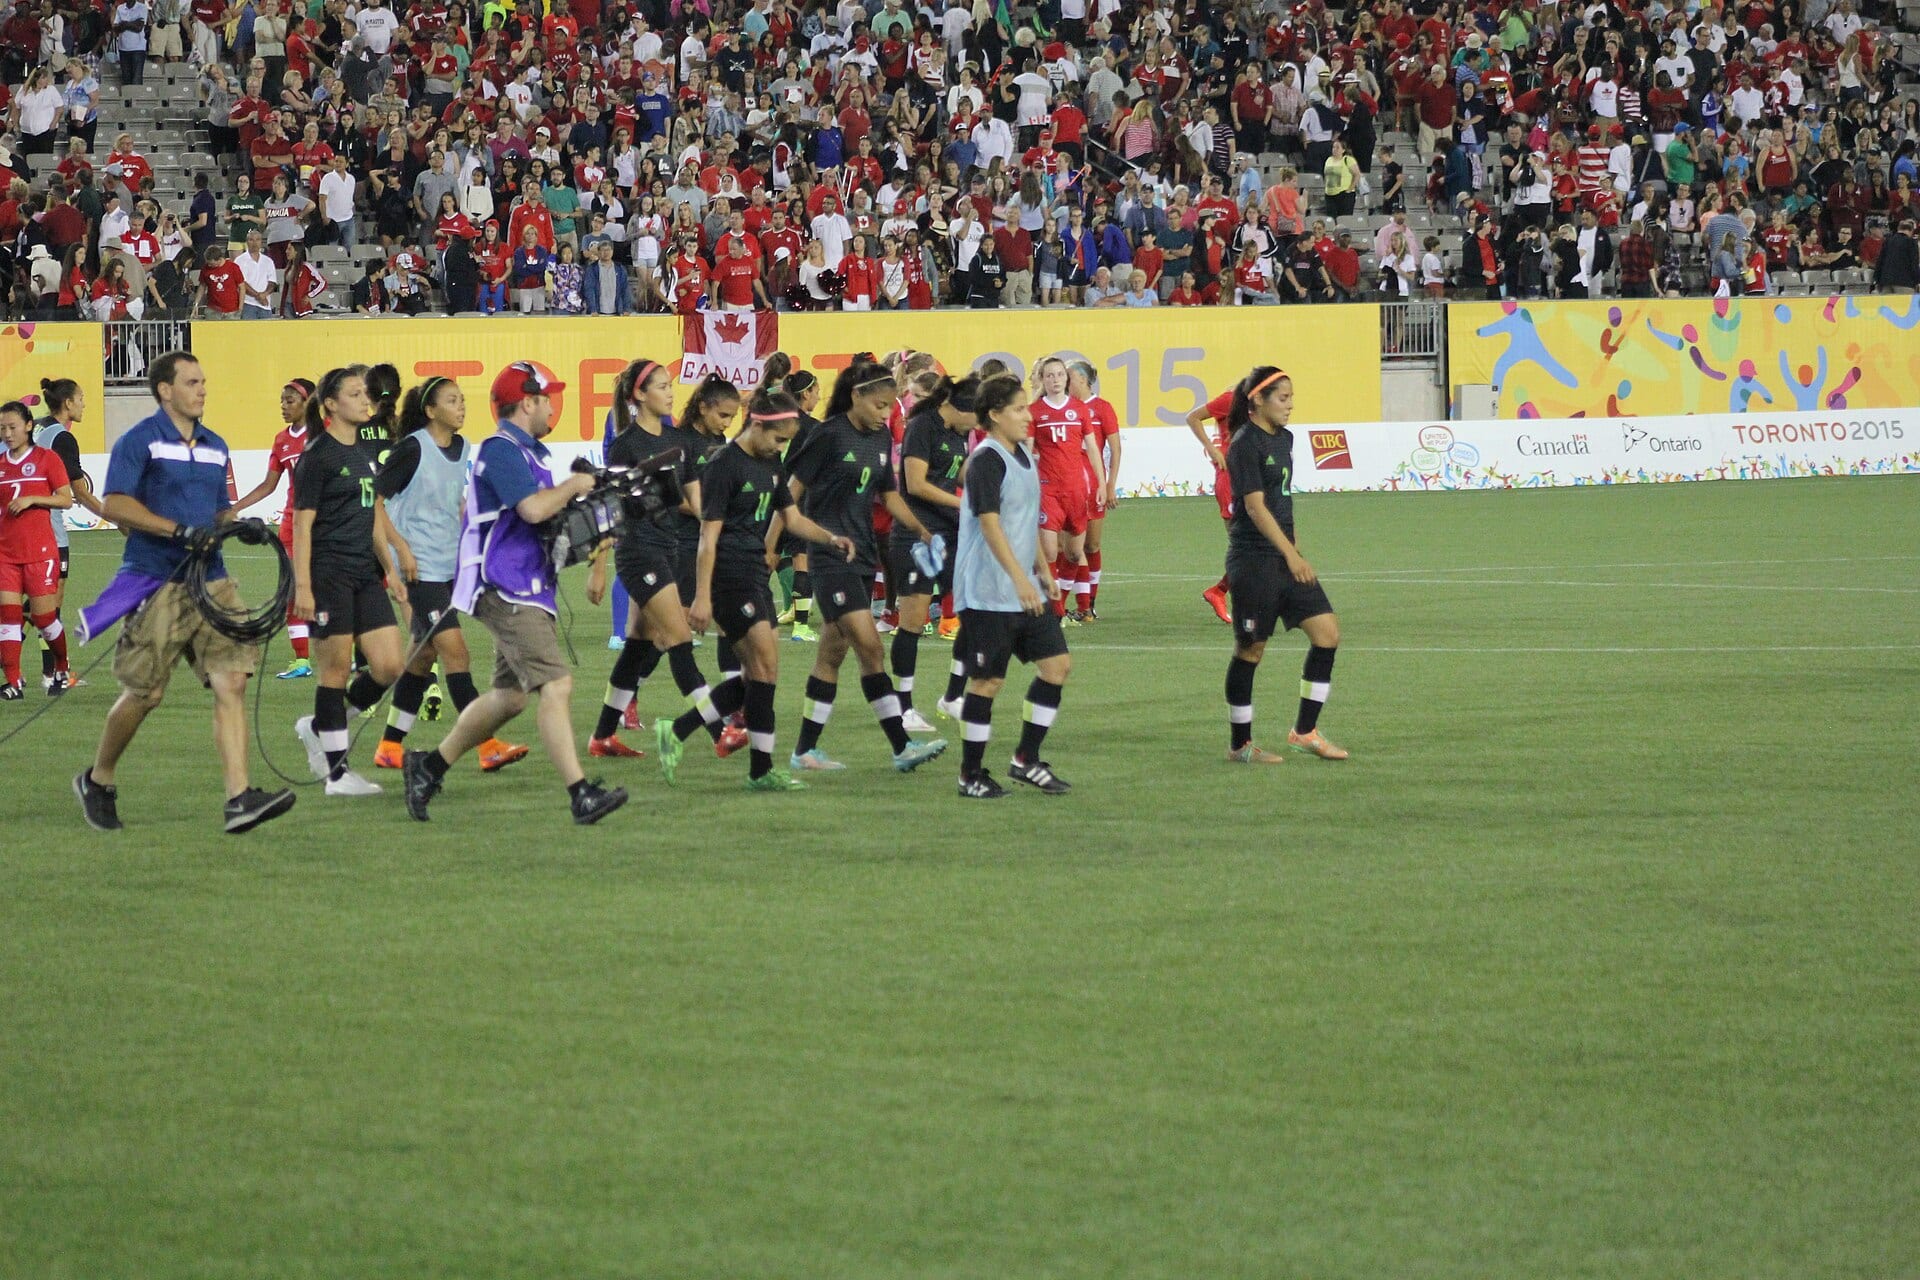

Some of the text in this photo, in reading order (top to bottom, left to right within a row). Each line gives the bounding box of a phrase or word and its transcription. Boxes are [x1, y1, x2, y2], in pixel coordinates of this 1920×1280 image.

[1050, 424, 1067, 443] 14
[1311, 432, 1347, 449] CIBC
[1649, 435, 1702, 453] Ontario
[1732, 420, 1904, 444] TORONTO 2015
[1516, 433, 1591, 457] Canada
[855, 466, 871, 494] 9
[1281, 467, 1291, 497] 2
[358, 477, 375, 508] 15
[754, 491, 773, 522] 11
[44, 558, 55, 578] 7
